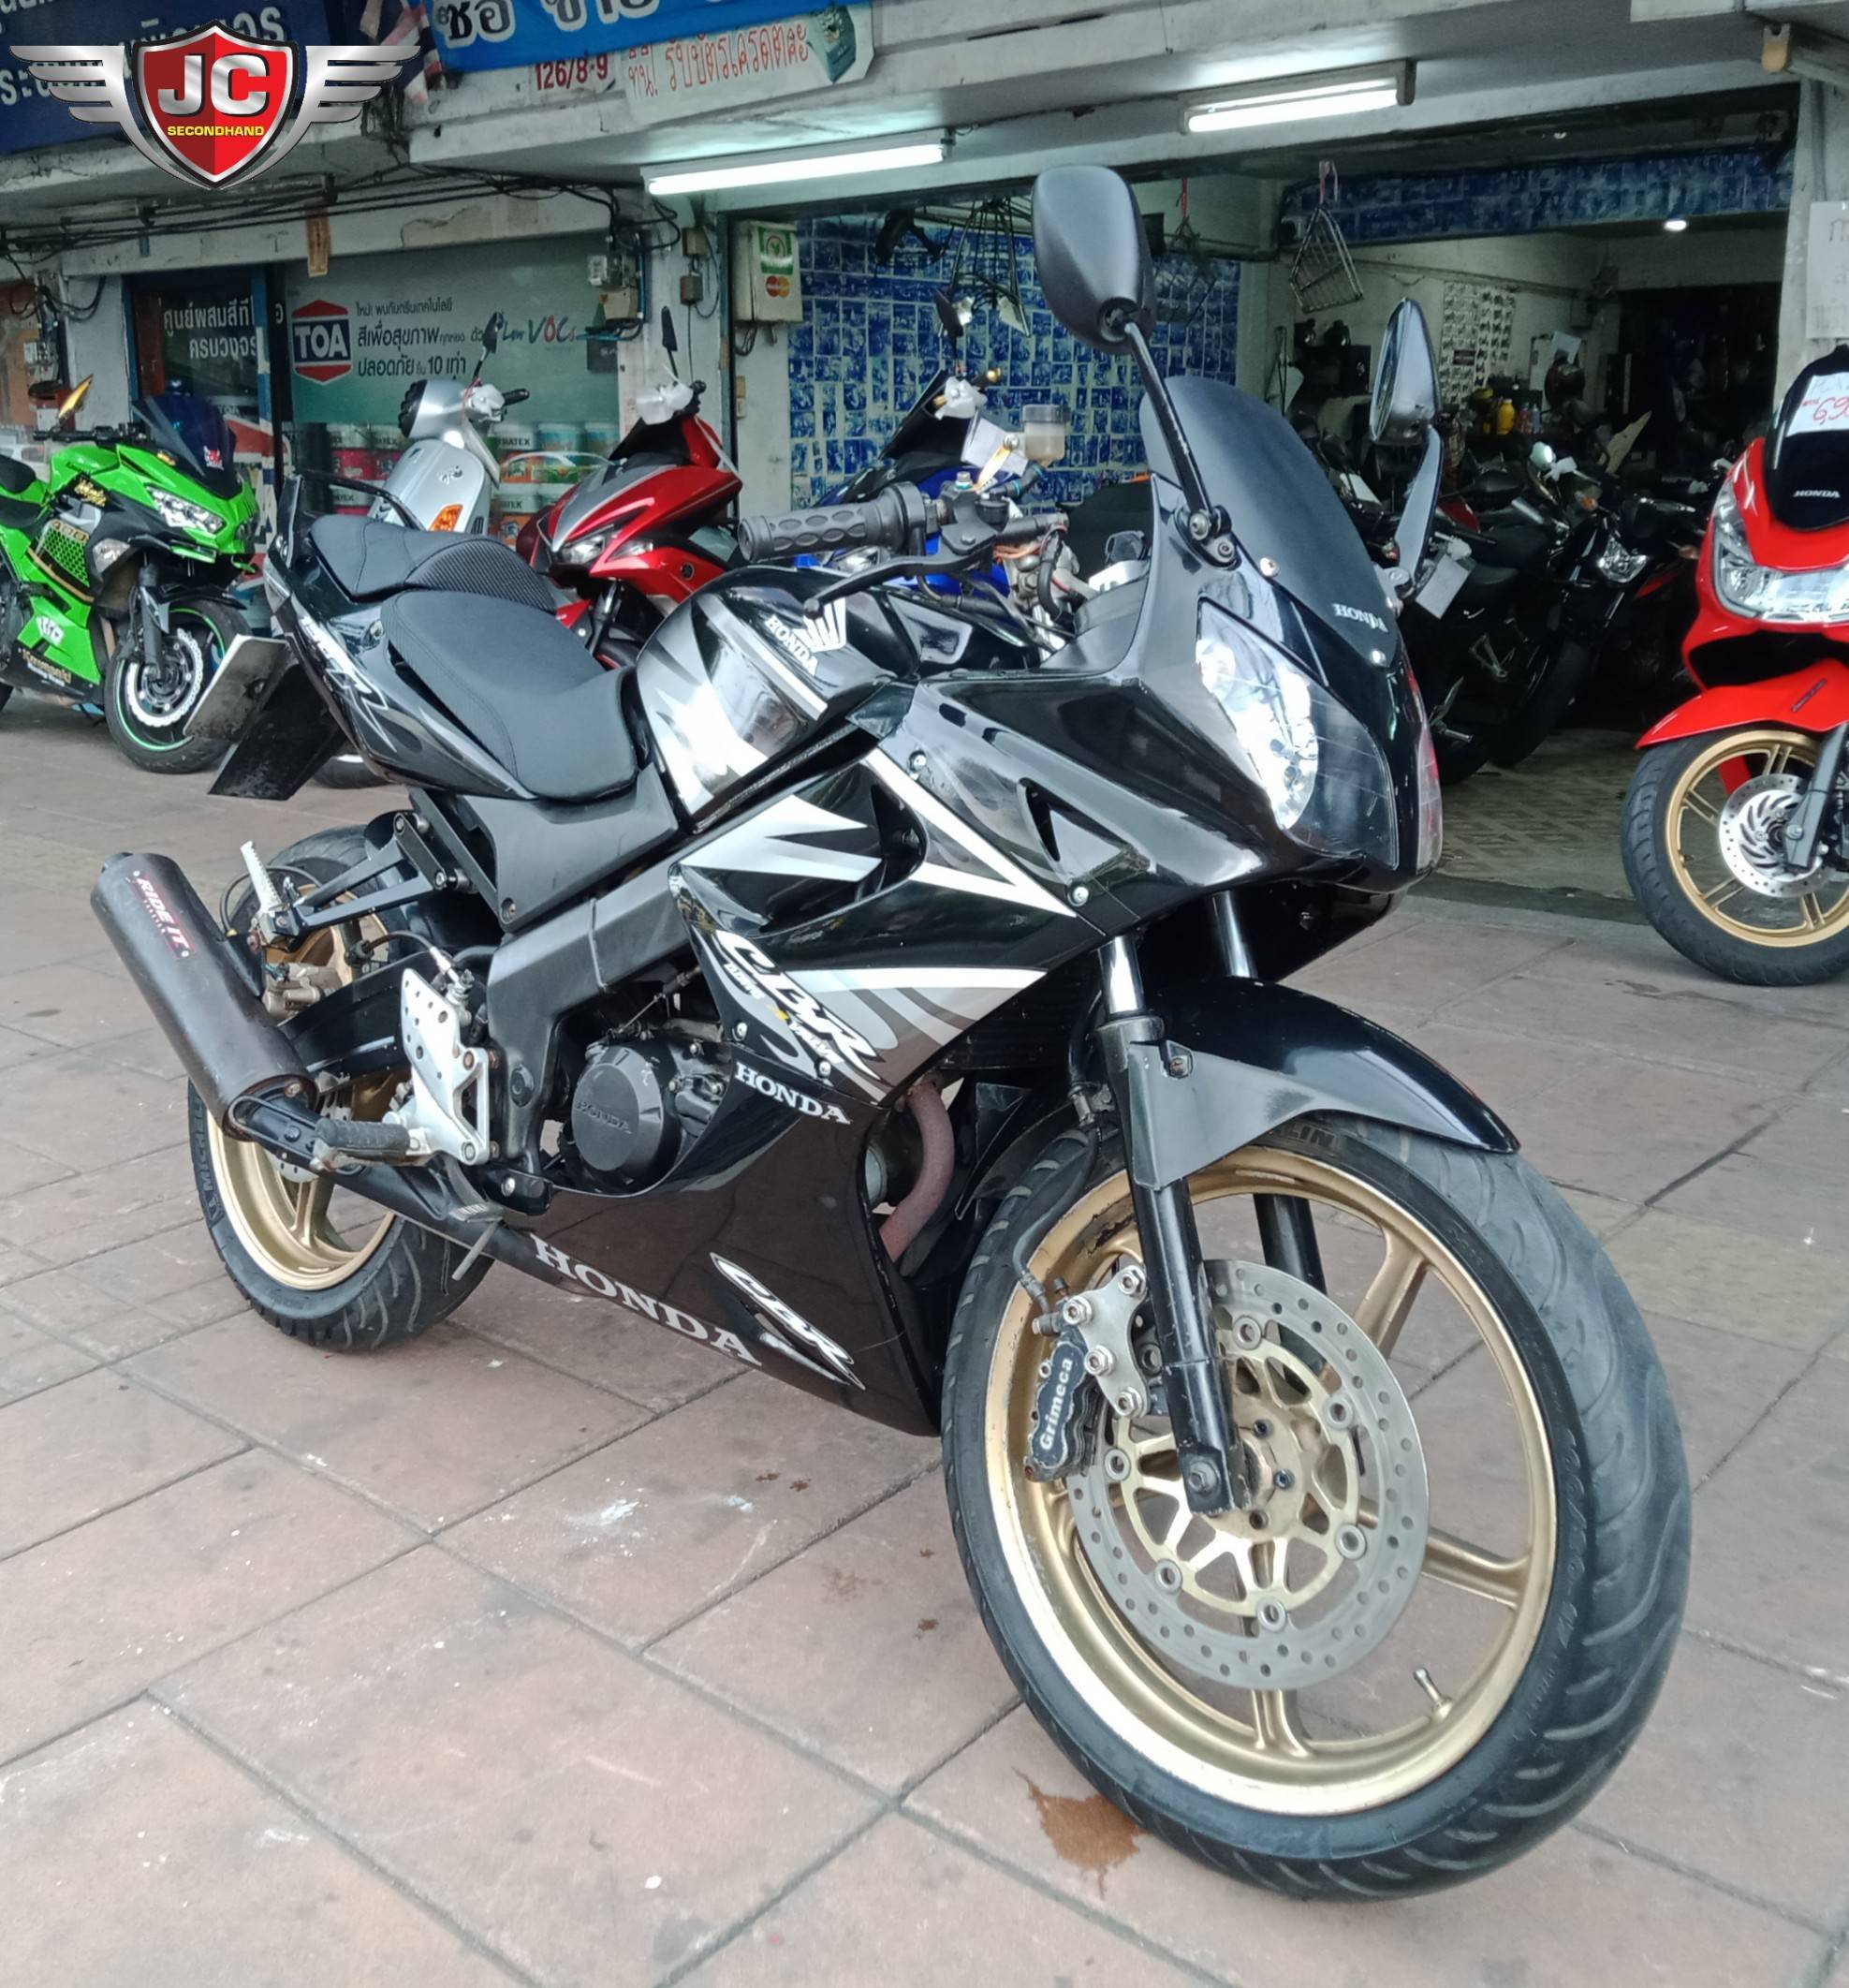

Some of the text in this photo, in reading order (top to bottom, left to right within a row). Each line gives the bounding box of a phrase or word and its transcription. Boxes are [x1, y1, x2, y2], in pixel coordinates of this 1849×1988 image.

[295, 326, 351, 361] TOA
[428, 356, 443, 375] 10
[1793, 490, 1841, 498] HONDA
[1331, 603, 1389, 633] HONDA
[764, 614, 819, 677] HONDA
[734, 1061, 851, 1125] HONDA
[529, 1232, 762, 1367] HONDA
[1039, 1358, 1074, 1451] Grimeca
